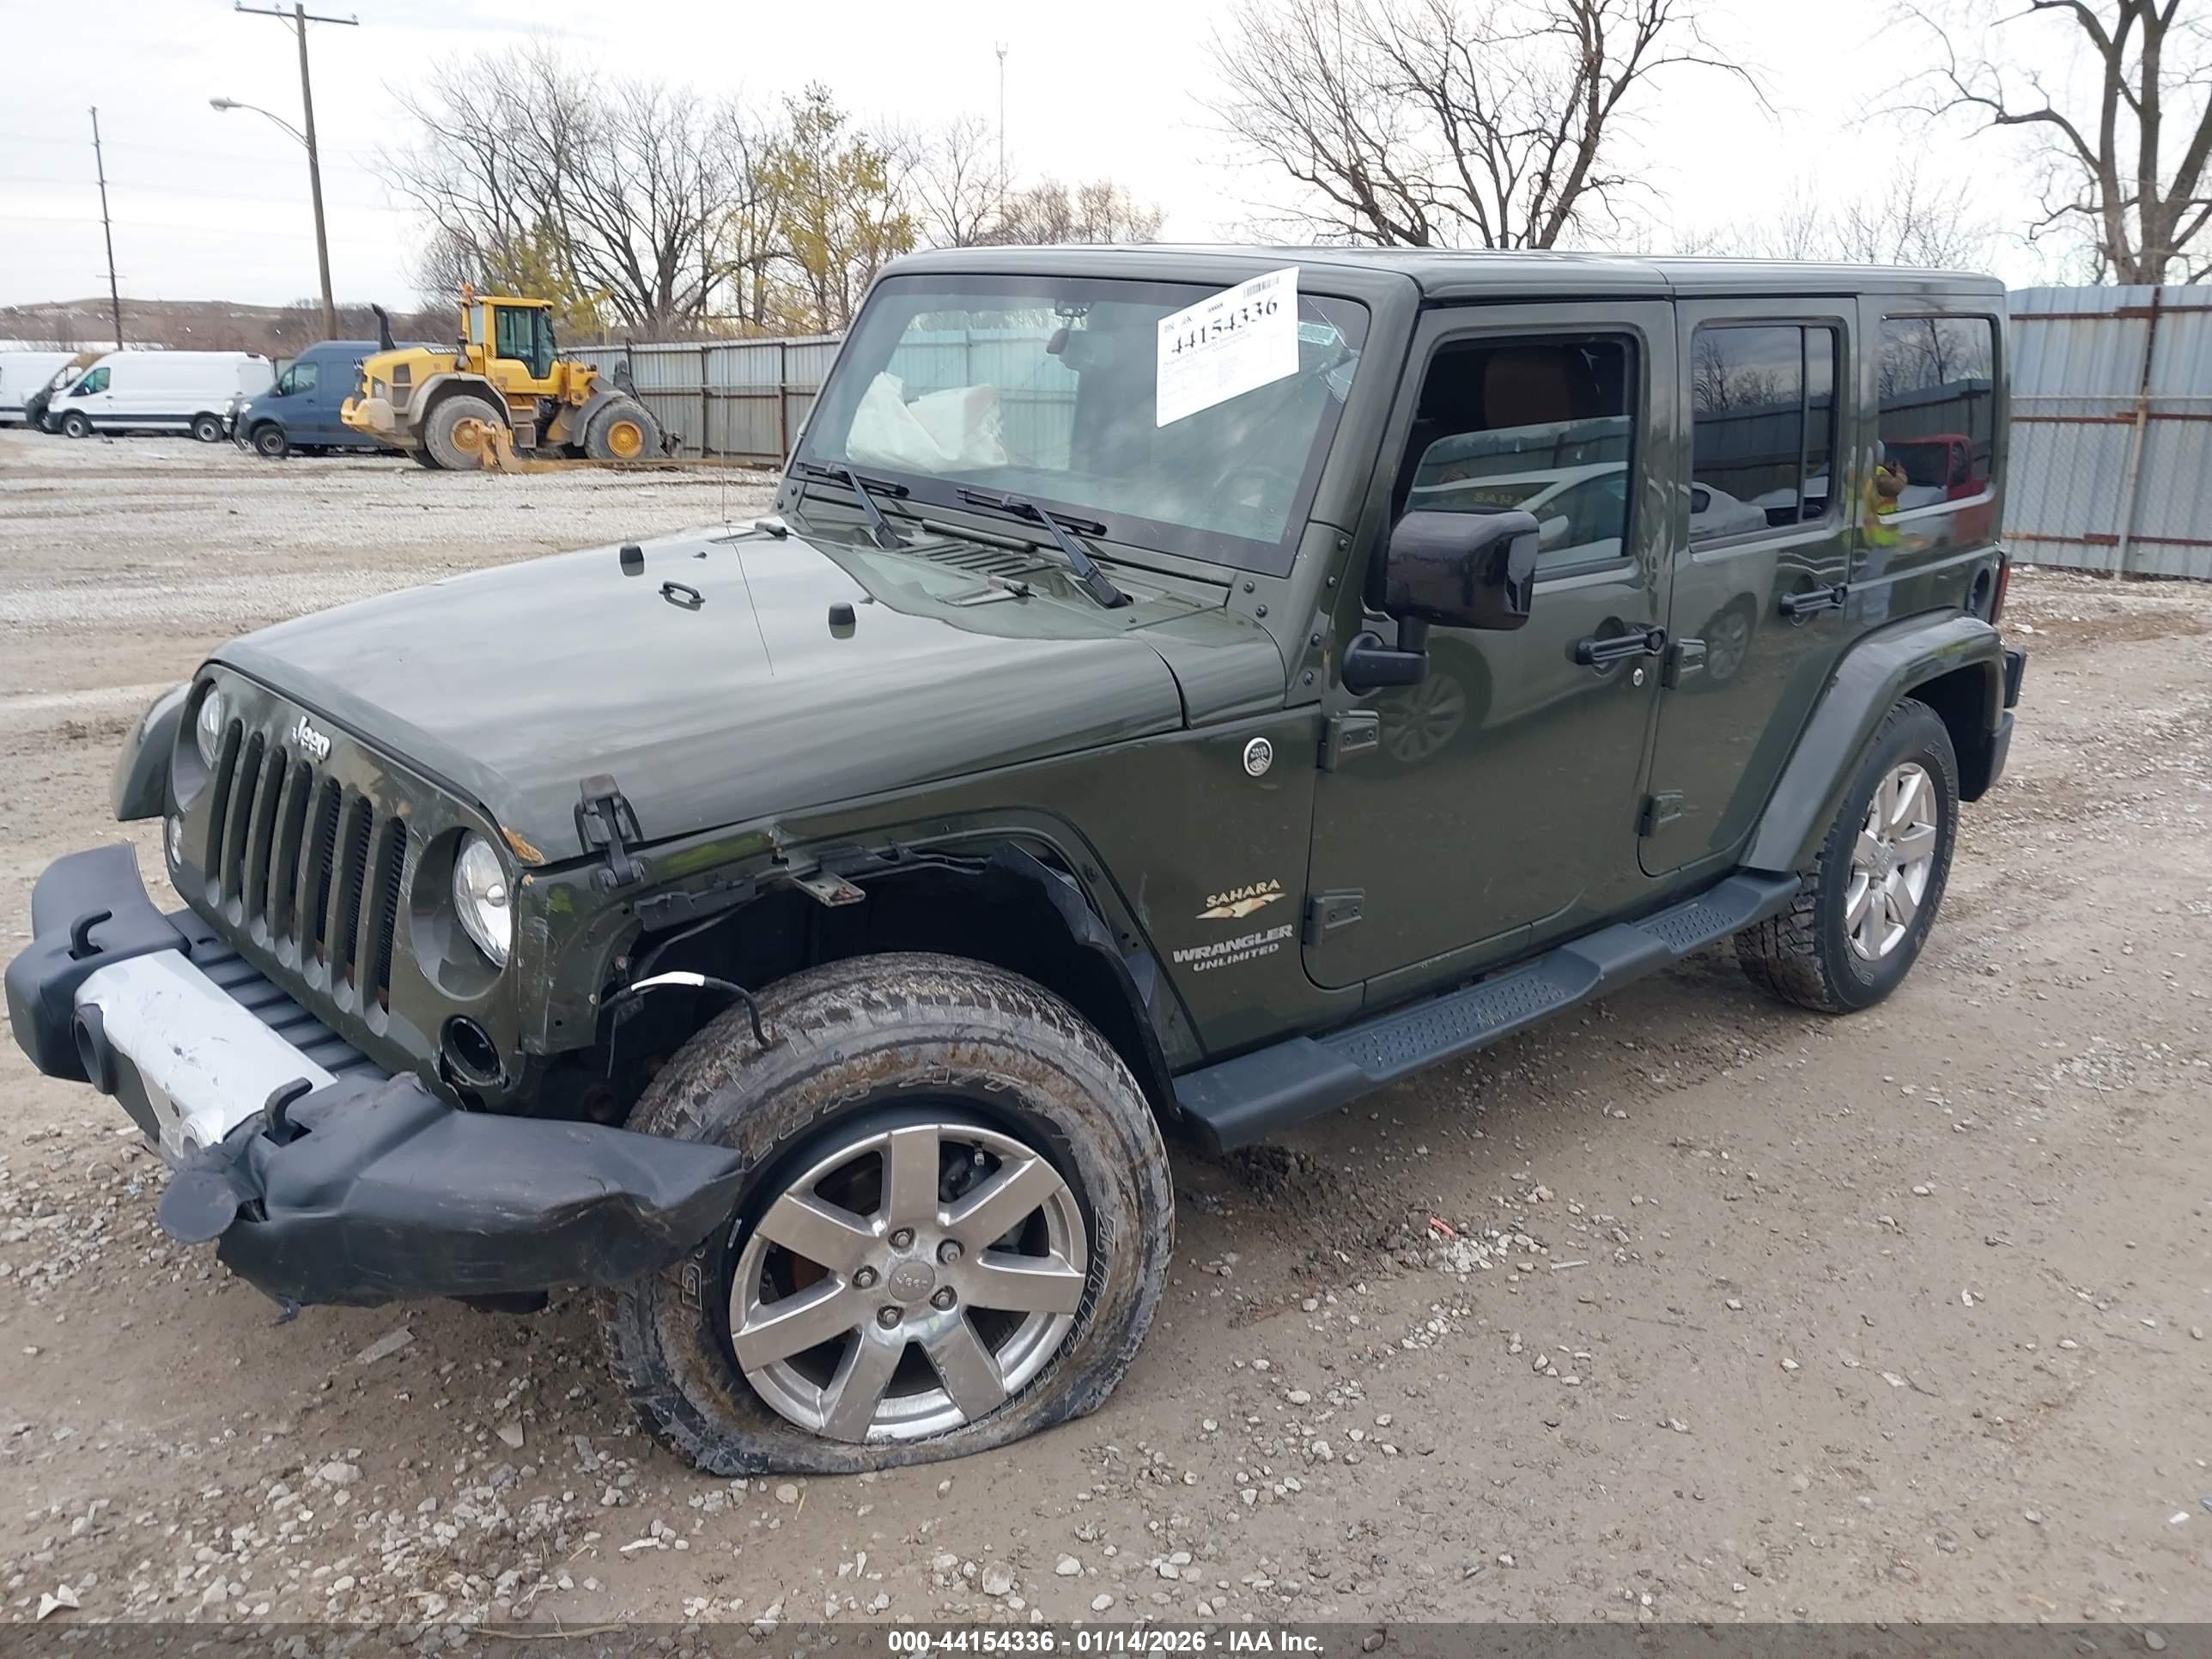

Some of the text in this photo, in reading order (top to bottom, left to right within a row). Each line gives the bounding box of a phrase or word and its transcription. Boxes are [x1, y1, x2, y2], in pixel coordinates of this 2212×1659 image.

[1170, 295, 1278, 354] 44154336
[291, 715, 331, 763] Jeep
[1206, 878, 1280, 908] SAHARA
[1173, 924, 1293, 963] WRANGLER
[1193, 943, 1279, 972] UNLIMITED
